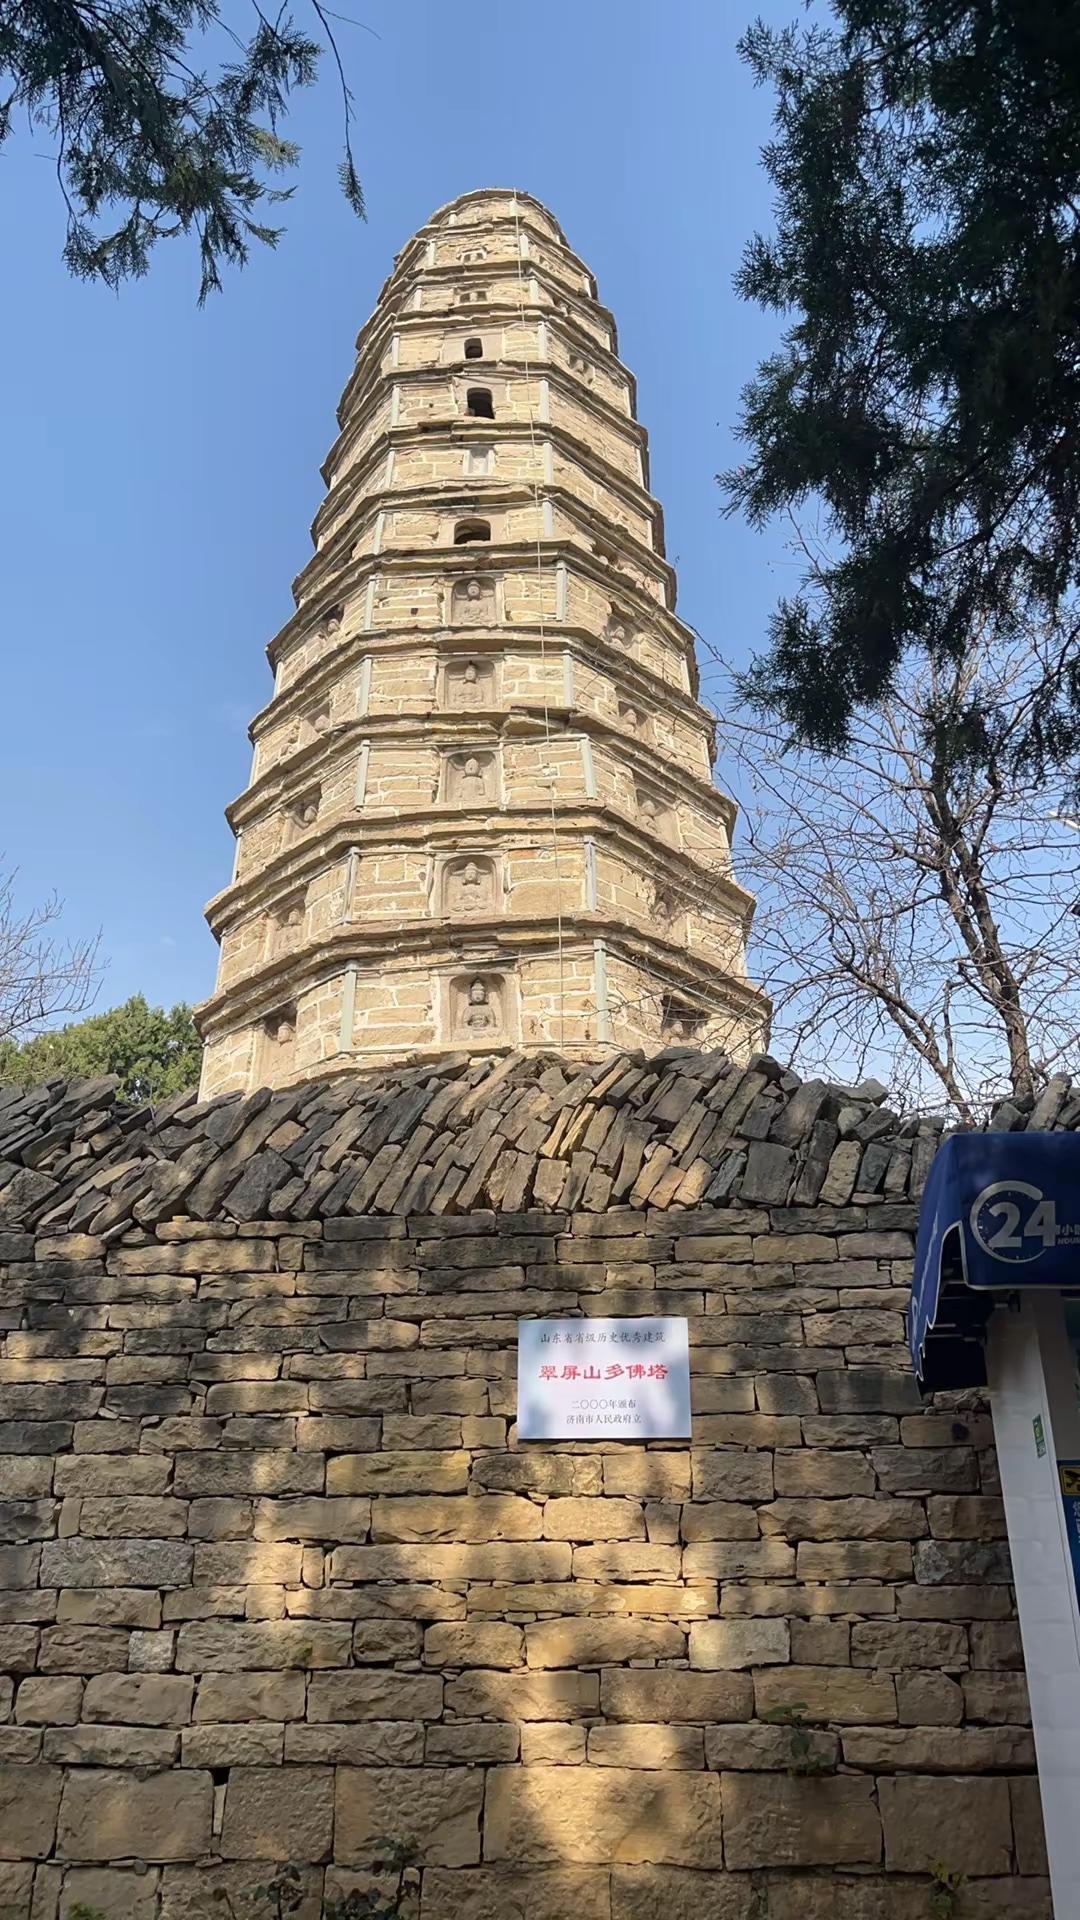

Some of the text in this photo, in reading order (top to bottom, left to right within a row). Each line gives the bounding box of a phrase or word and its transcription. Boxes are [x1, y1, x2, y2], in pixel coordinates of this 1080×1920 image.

[988, 1201, 1056, 1248] 24
[540, 1331, 666, 1344] 山东省省级历史优秀建筑
[538, 1363, 669, 1381] 翠屏山多佛塔
[566, 1414, 642, 1425] 济南市人民政府立
